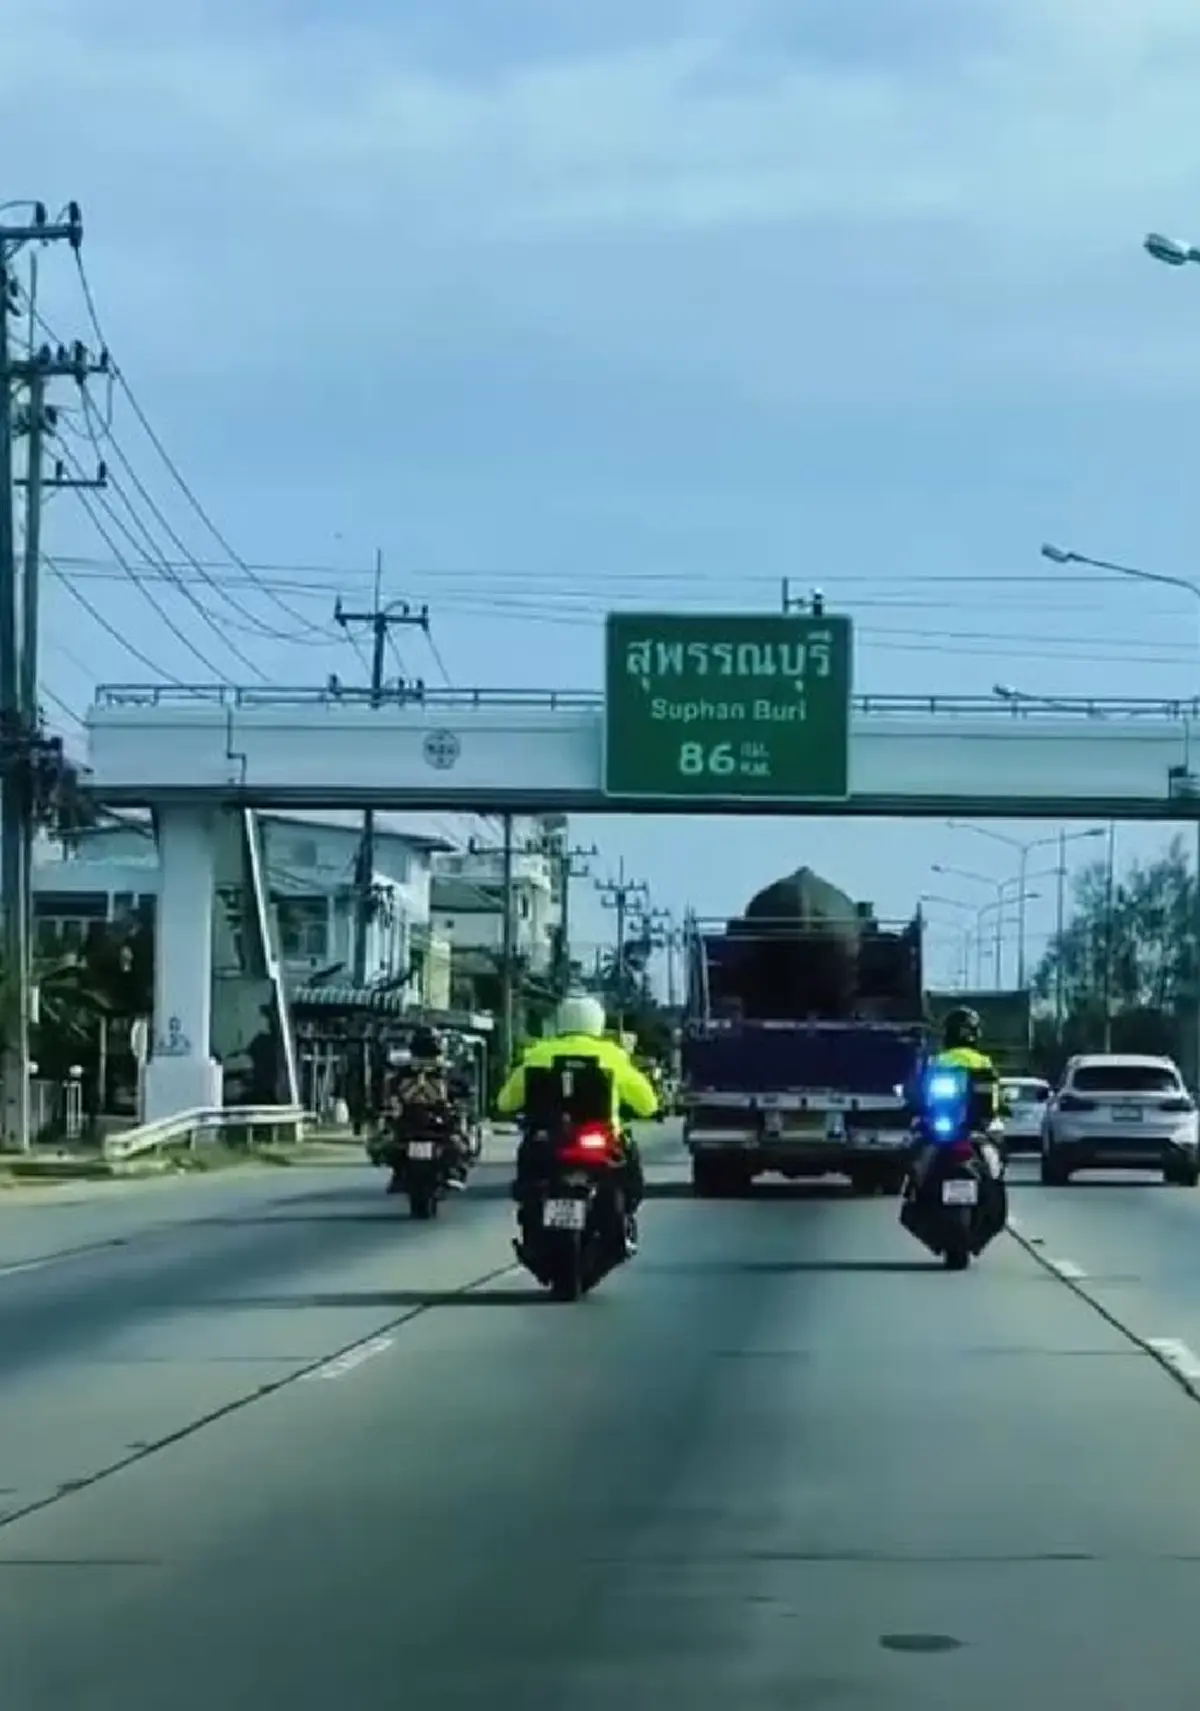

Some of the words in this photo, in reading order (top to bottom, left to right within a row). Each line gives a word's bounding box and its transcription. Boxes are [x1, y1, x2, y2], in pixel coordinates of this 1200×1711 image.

[626, 630, 832, 693] สุพรรณบุรี
[651, 697, 745, 722] Suphan
[752, 698, 807, 721] Buri
[680, 741, 735, 775] 86
